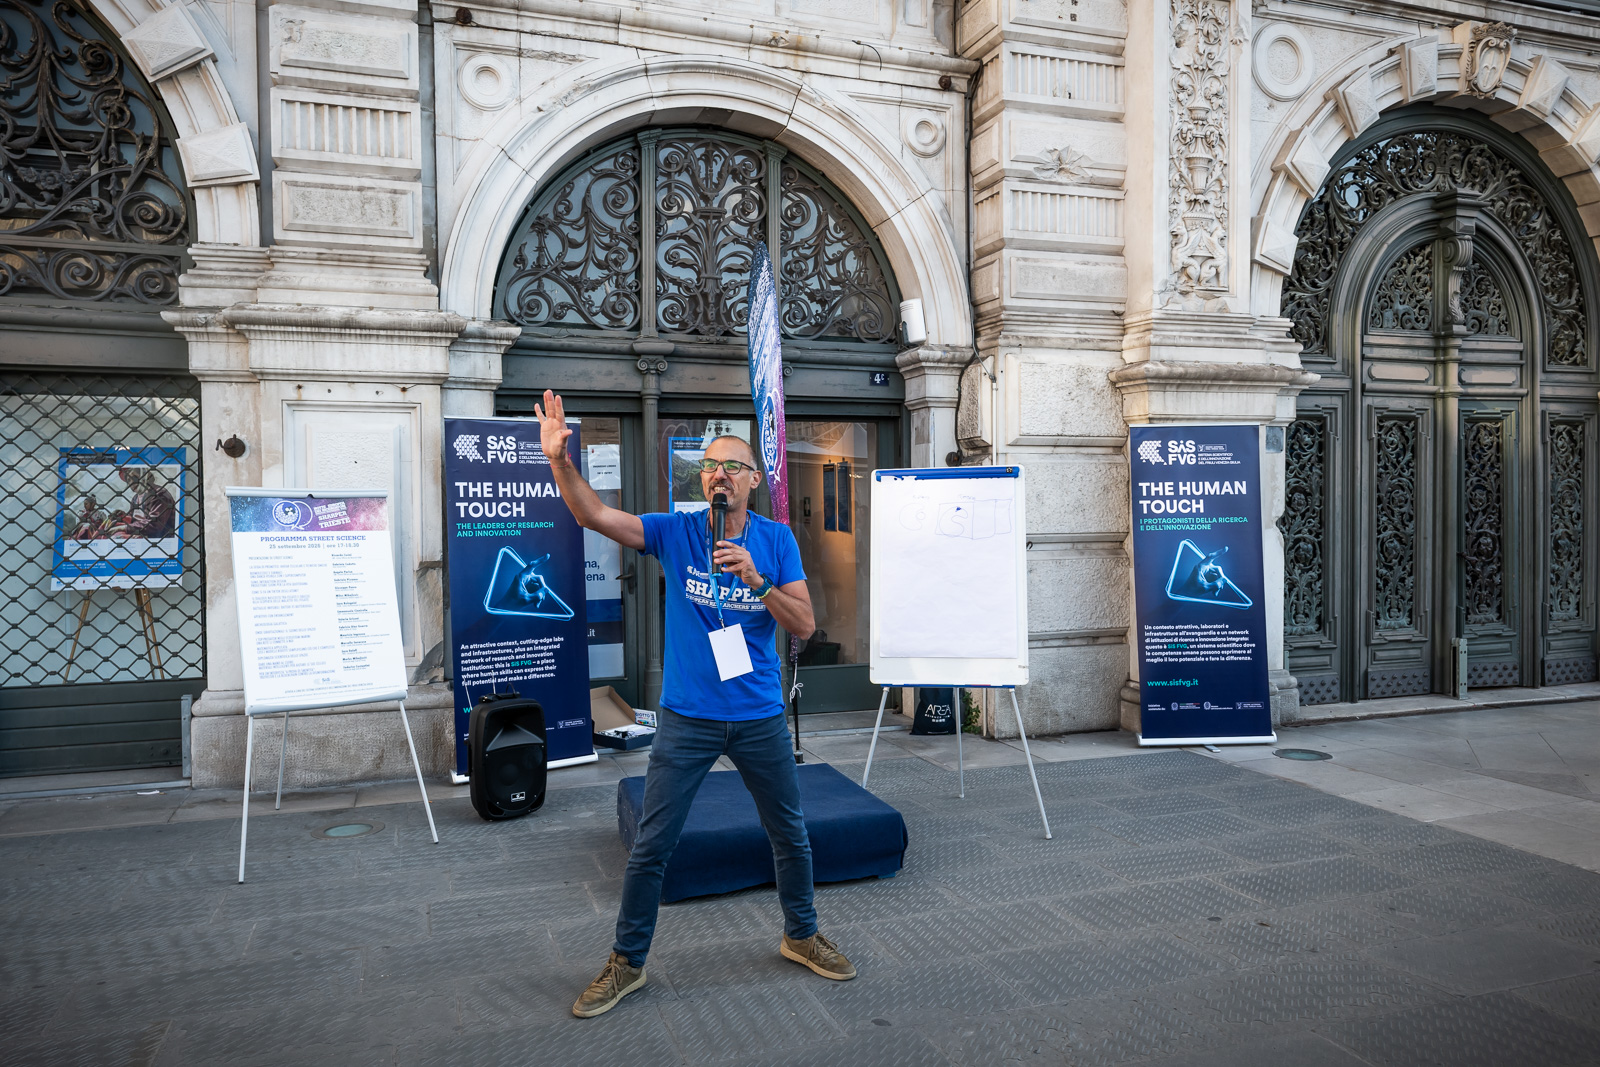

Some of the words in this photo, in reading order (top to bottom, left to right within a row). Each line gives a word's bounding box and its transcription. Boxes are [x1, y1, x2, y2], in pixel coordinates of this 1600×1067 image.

[487, 451, 517, 463] FVG
[1168, 454, 1196, 465] FVG
[455, 482, 493, 497] THE
[1139, 482, 1174, 496] THE
[1179, 481, 1246, 495] HUMAN
[456, 502, 525, 518] TOUCH
[1139, 499, 1204, 514] TOUCH
[319, 516, 351, 528] TRIESTE
[686, 579, 764, 602] SHARPE
[473, 648, 513, 656] infrastructures,
[472, 678, 497, 686] potential
[1147, 678, 1199, 687] www.sisfvg.it
[925, 704, 951, 715] AREA
